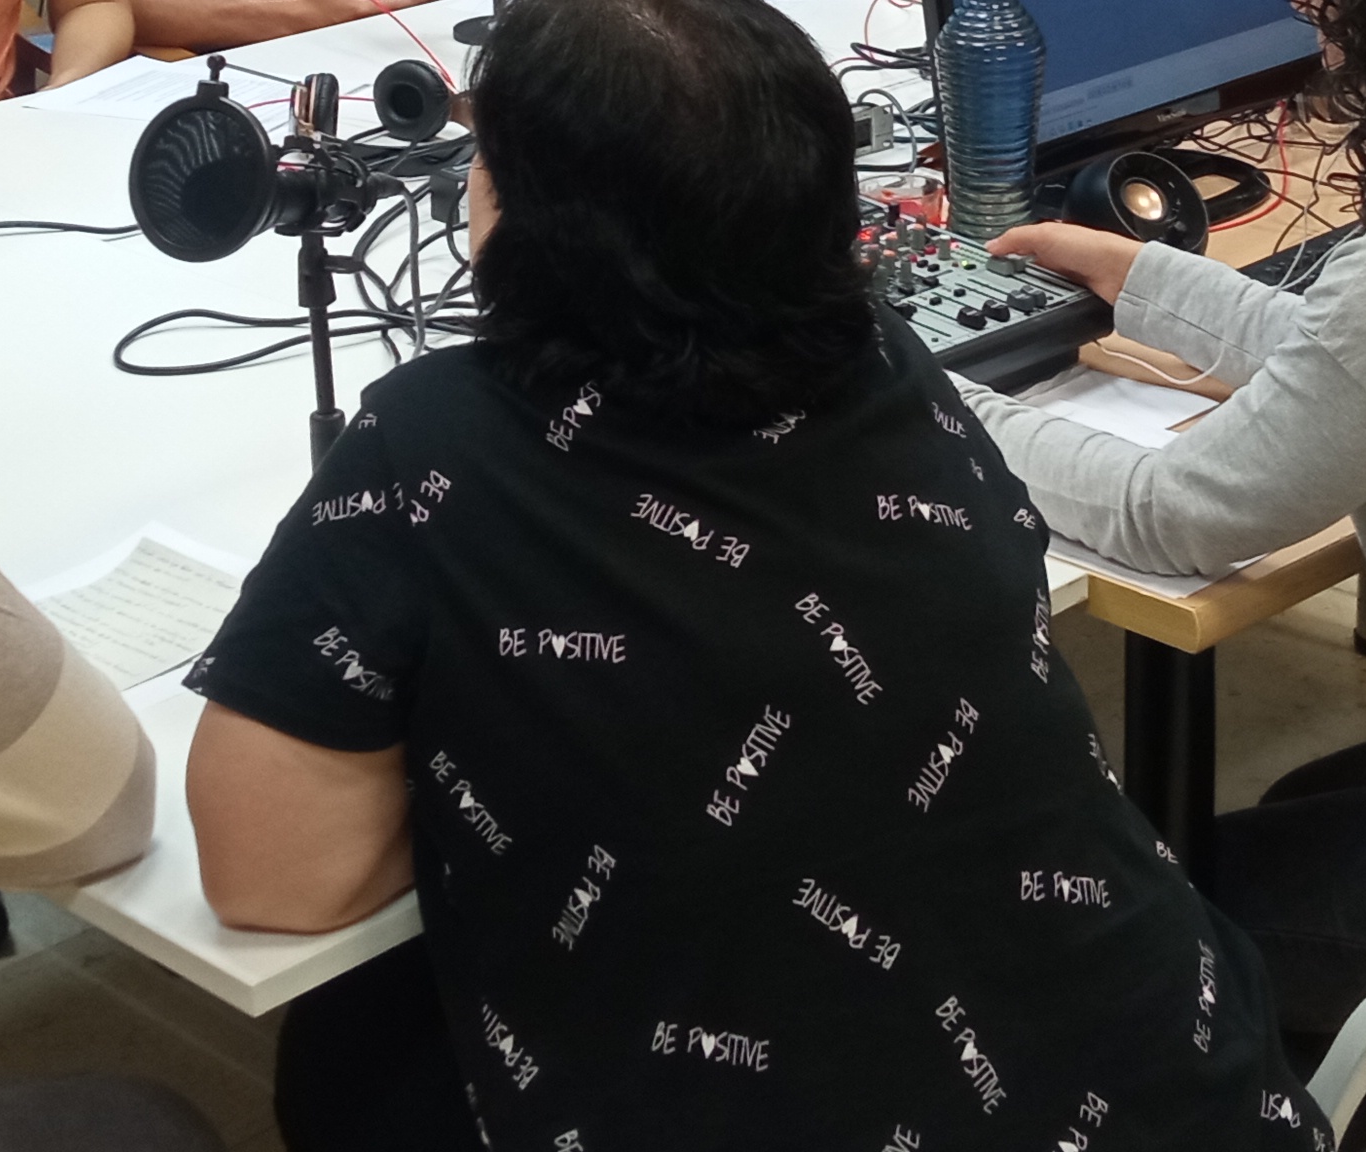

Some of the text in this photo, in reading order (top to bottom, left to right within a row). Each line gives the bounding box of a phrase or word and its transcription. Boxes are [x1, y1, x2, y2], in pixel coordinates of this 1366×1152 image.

[546, 419, 573, 452] BE
[877, 494, 903, 520] BE
[1013, 508, 1035, 529] BE
[716, 536, 751, 568] BE
[795, 593, 830, 624] BE
[313, 626, 348, 656] BE
[499, 628, 527, 657] BE
[955, 697, 979, 734] BE
[430, 751, 456, 782] BE
[706, 789, 739, 827] BE
[588, 845, 616, 880] BE
[1156, 841, 1179, 864] BE
[1021, 870, 1045, 901] BE
[869, 935, 901, 970] BE
[935, 995, 966, 1031] BE
[651, 1021, 678, 1054] BE
[1193, 1019, 1211, 1054] BE
[512, 1055, 540, 1091] BE
[1080, 1092, 1109, 1128] BE
